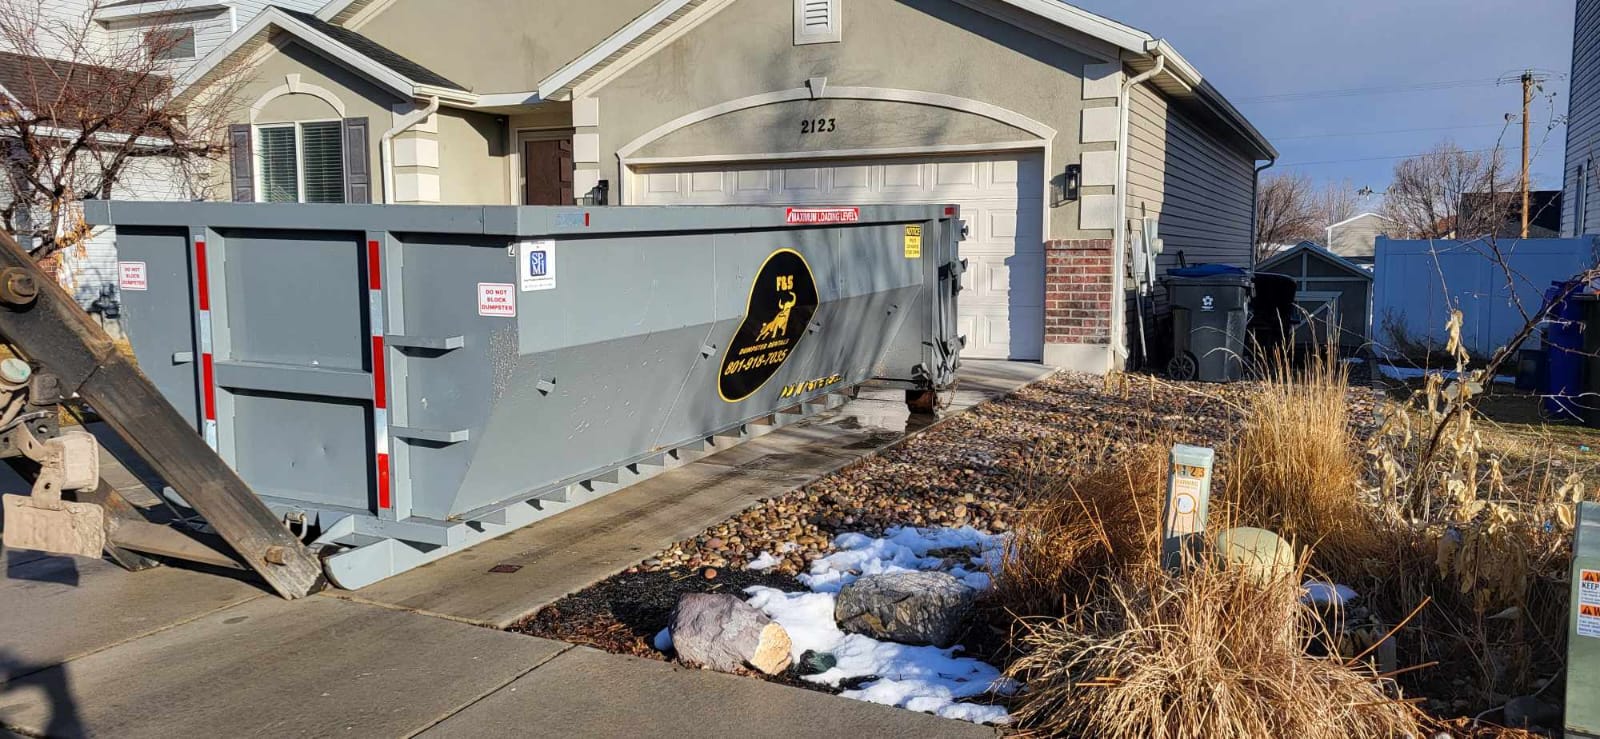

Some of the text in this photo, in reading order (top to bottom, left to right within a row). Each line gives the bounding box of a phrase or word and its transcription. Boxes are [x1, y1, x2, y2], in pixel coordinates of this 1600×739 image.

[801, 118, 836, 134] 2123
[791, 211, 855, 222] MAXIMUM LOADING LEVEL
[739, 343, 768, 355] DUMPSTER
[724, 349, 788, 375] 801-918-7035
